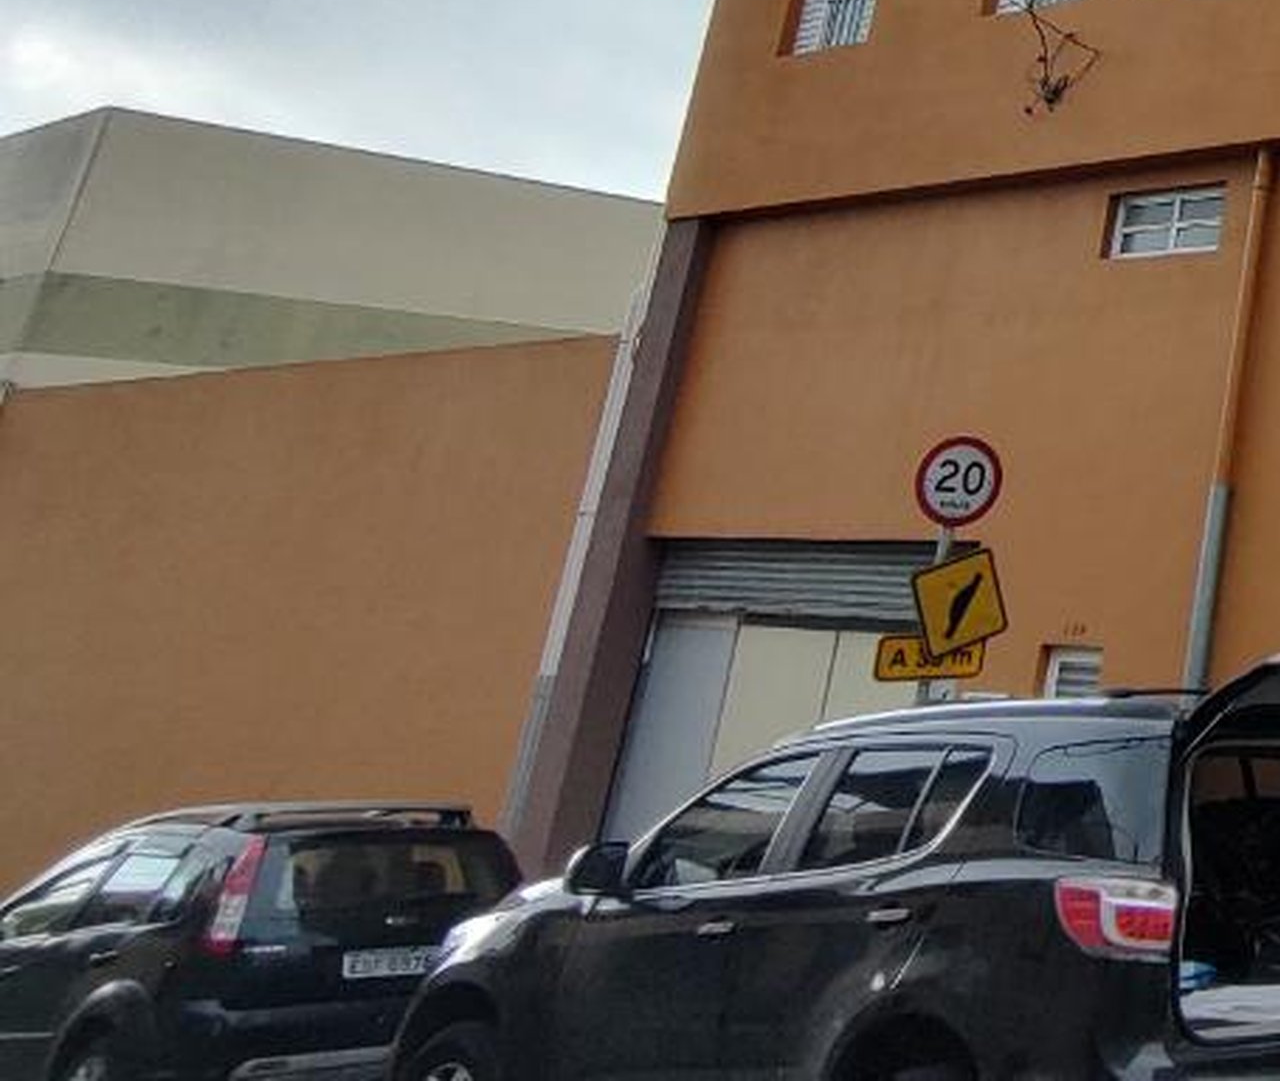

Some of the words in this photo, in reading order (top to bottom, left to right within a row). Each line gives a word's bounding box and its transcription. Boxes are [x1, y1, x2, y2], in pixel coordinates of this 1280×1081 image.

[934, 458, 986, 496] 20
[889, 647, 908, 668] A
[951, 649, 973, 667] m
